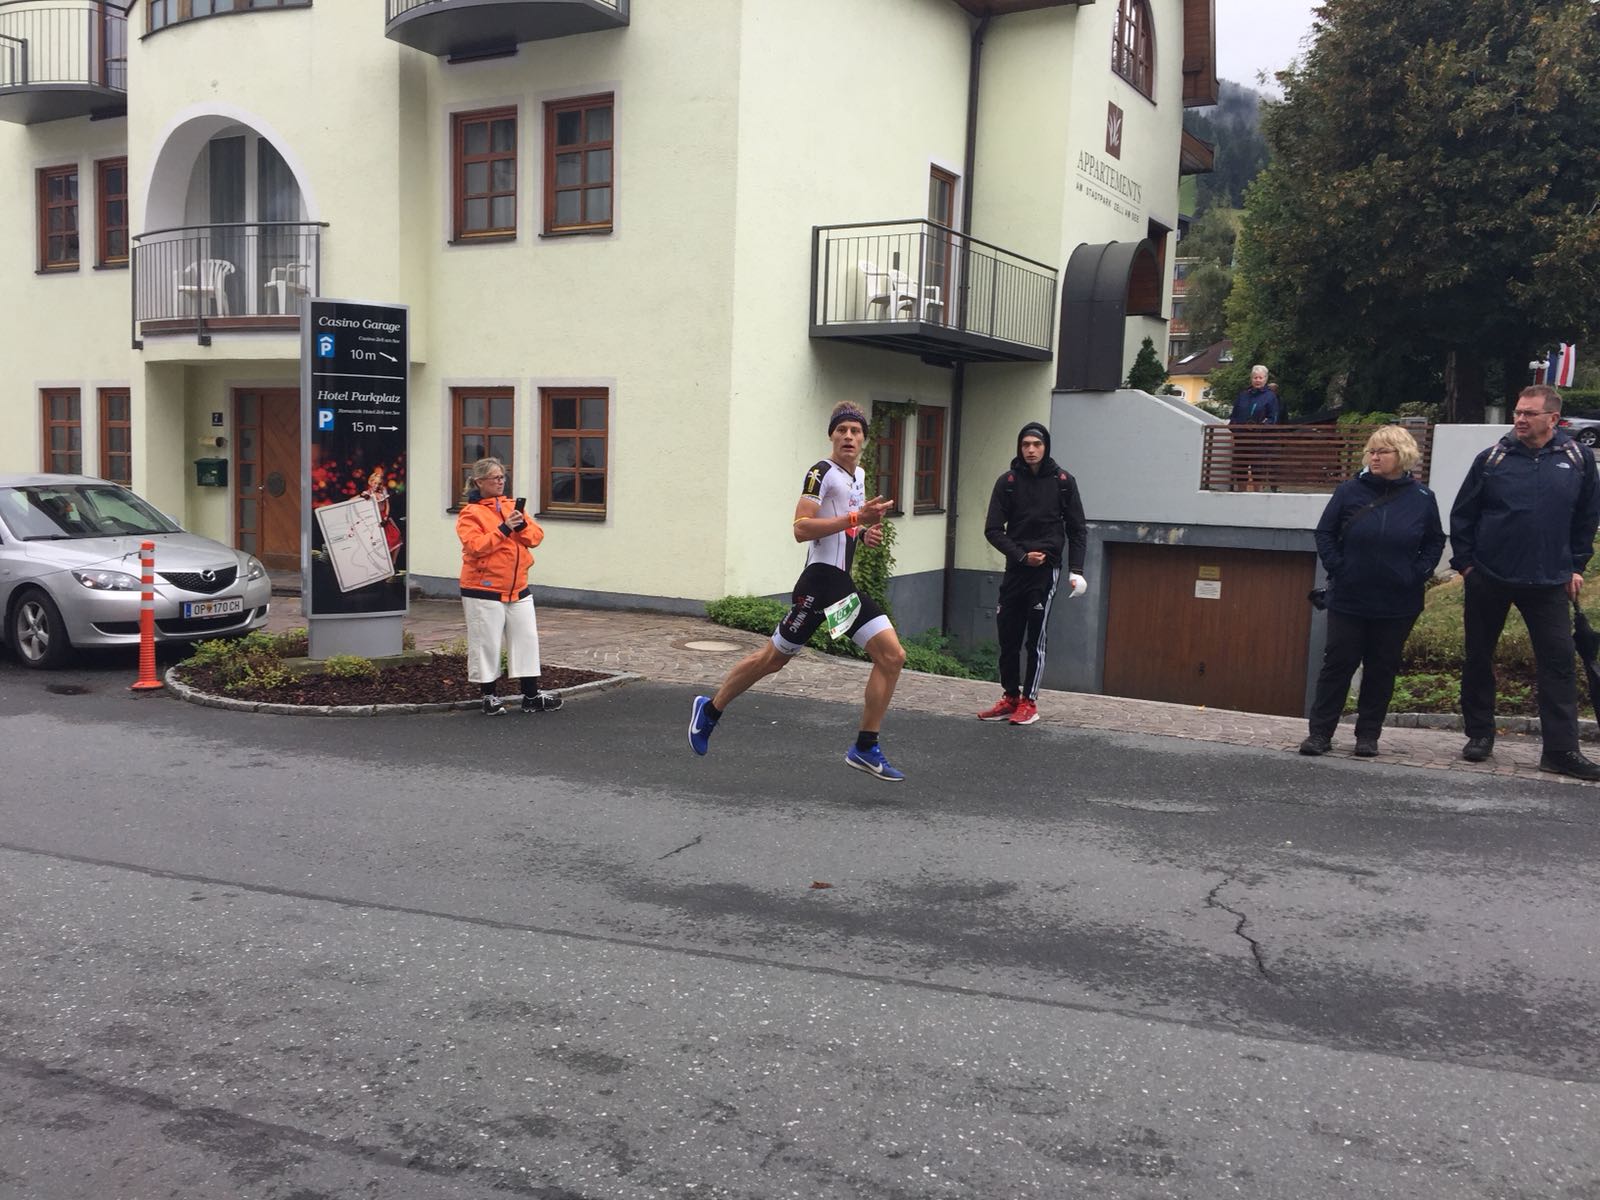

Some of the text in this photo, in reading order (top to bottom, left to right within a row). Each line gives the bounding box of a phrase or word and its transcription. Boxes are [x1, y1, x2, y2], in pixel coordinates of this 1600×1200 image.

[1077, 149, 1142, 204] APPARTEMENTS
[318, 316, 400, 333] Casino Garage
[350, 349, 376, 360] 10 m
[318, 390, 400, 404] Hotel Parkplatz
[319, 410, 334, 428] P
[352, 422, 376, 432] 15 m
[194, 604, 206, 615] OP
[789, 594, 815, 633] RUNING
